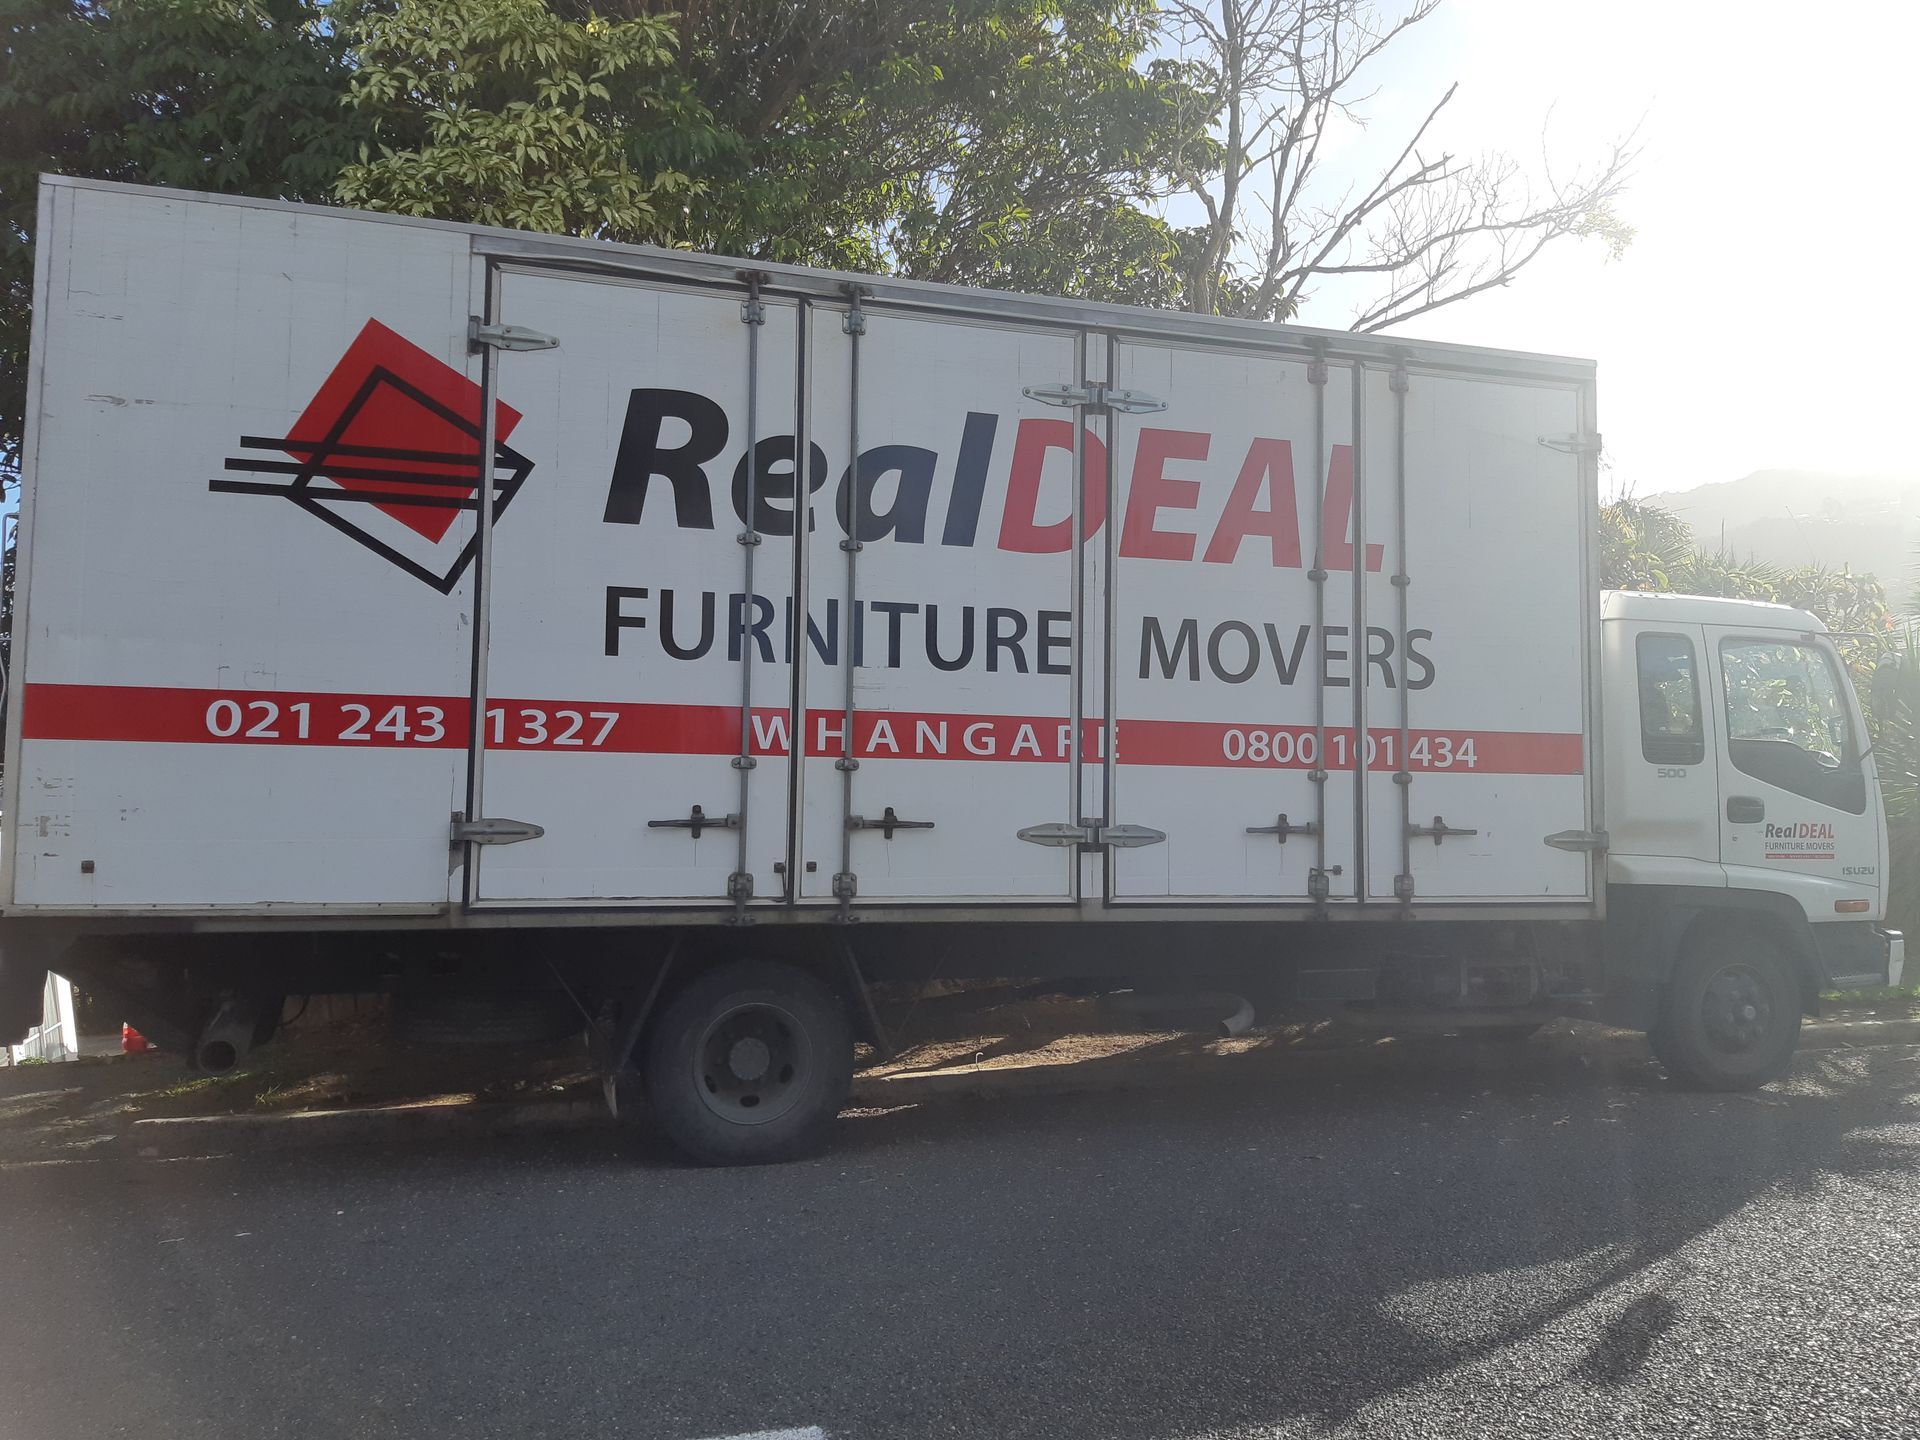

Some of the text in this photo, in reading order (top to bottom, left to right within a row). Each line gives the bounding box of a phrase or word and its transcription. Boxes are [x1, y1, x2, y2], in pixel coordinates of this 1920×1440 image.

[604, 585, 1436, 690] FURNITURE MOVERS
[205, 699, 620, 747] 021 243 1327
[1222, 729, 1318, 764] 0800
[1409, 736, 1478, 768] 434
[1657, 768, 1687, 778] 500
[1764, 841, 1835, 850] FURNITURE MOVERS
[1842, 866, 1875, 875] ISUZU
